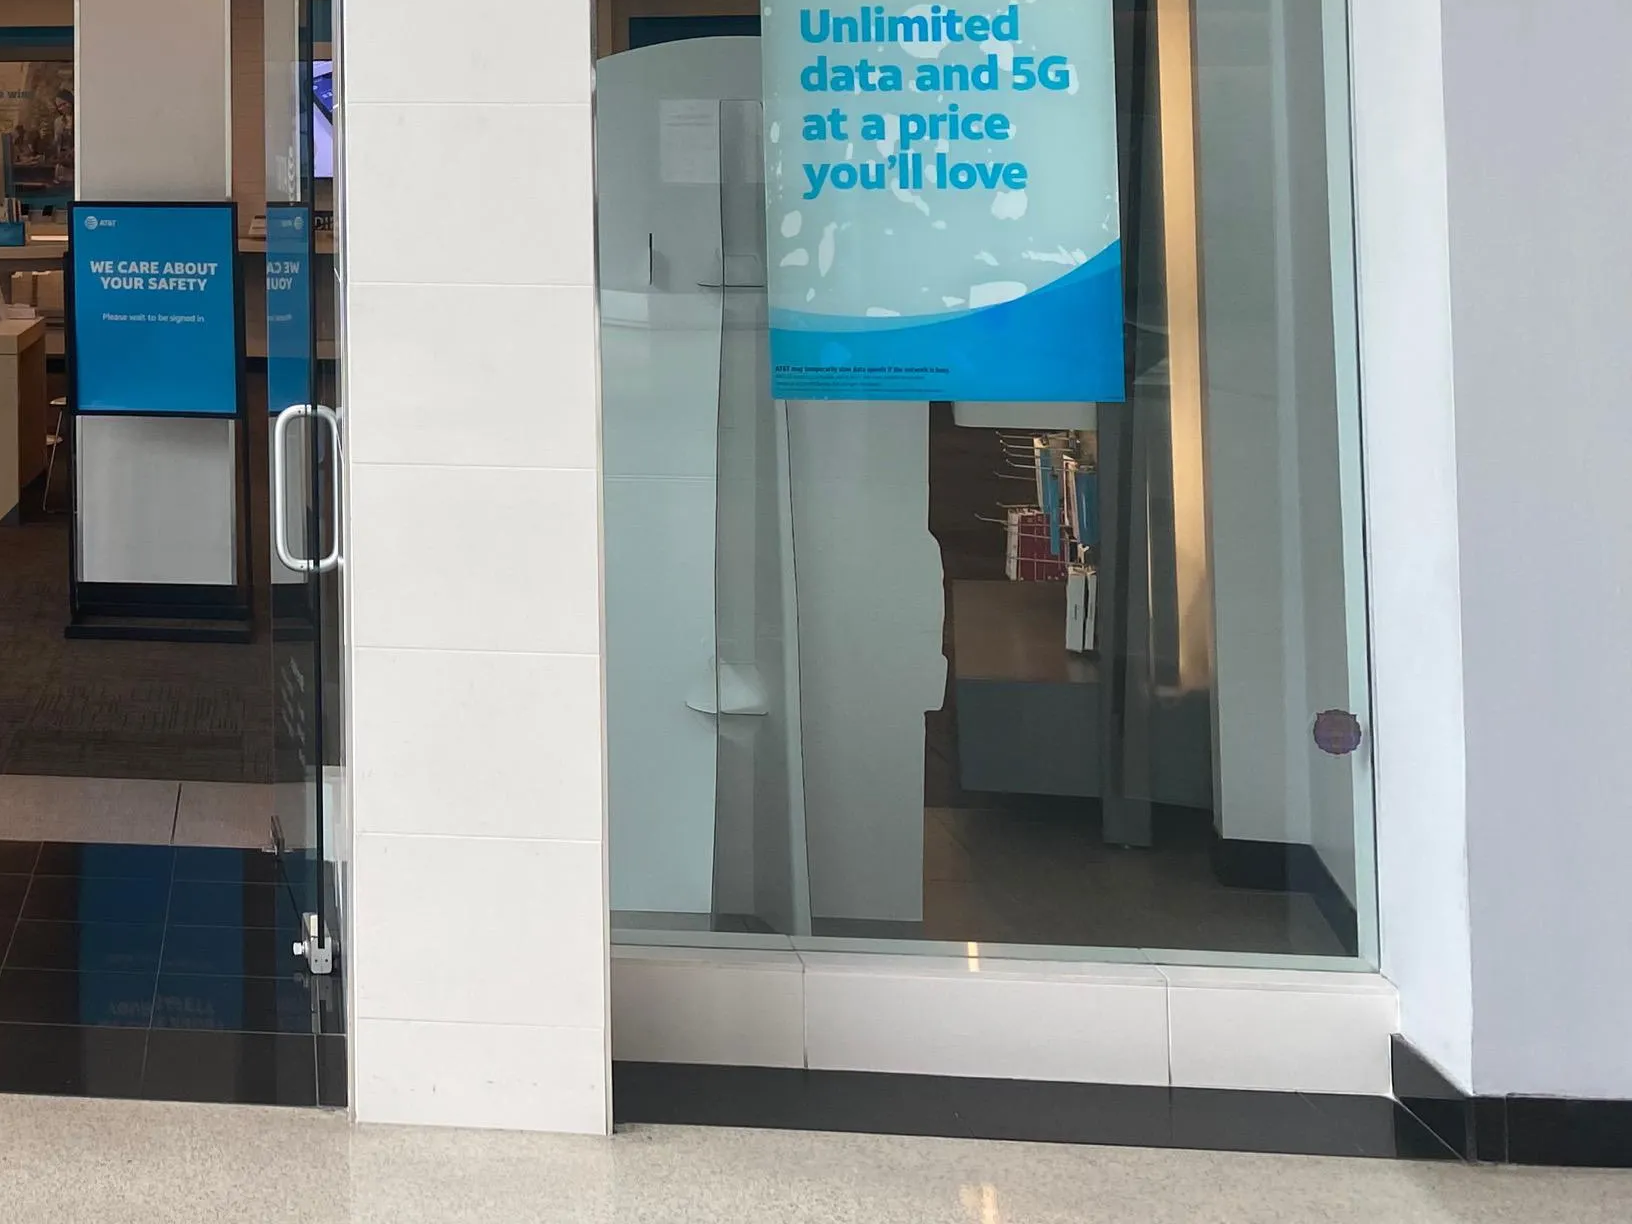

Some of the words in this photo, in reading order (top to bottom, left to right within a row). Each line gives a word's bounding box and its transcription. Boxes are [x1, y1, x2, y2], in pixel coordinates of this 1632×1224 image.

[799, 5, 1020, 44] Unlimited
[799, 55, 904, 92] data
[914, 53, 1000, 92] and
[1011, 55, 1071, 91] 5G
[801, 107, 849, 142] at
[860, 112, 886, 142] a
[899, 104, 1011, 150] price
[801, 153, 924, 200] you'll
[935, 152, 1029, 191] love
[90, 260, 114, 274] WE
[117, 261, 160, 275] CARE
[159, 262, 218, 276] ABOUT
[100, 276, 145, 290] YOUR
[148, 277, 208, 292] SAFETY
[102, 312, 128, 322] Please
